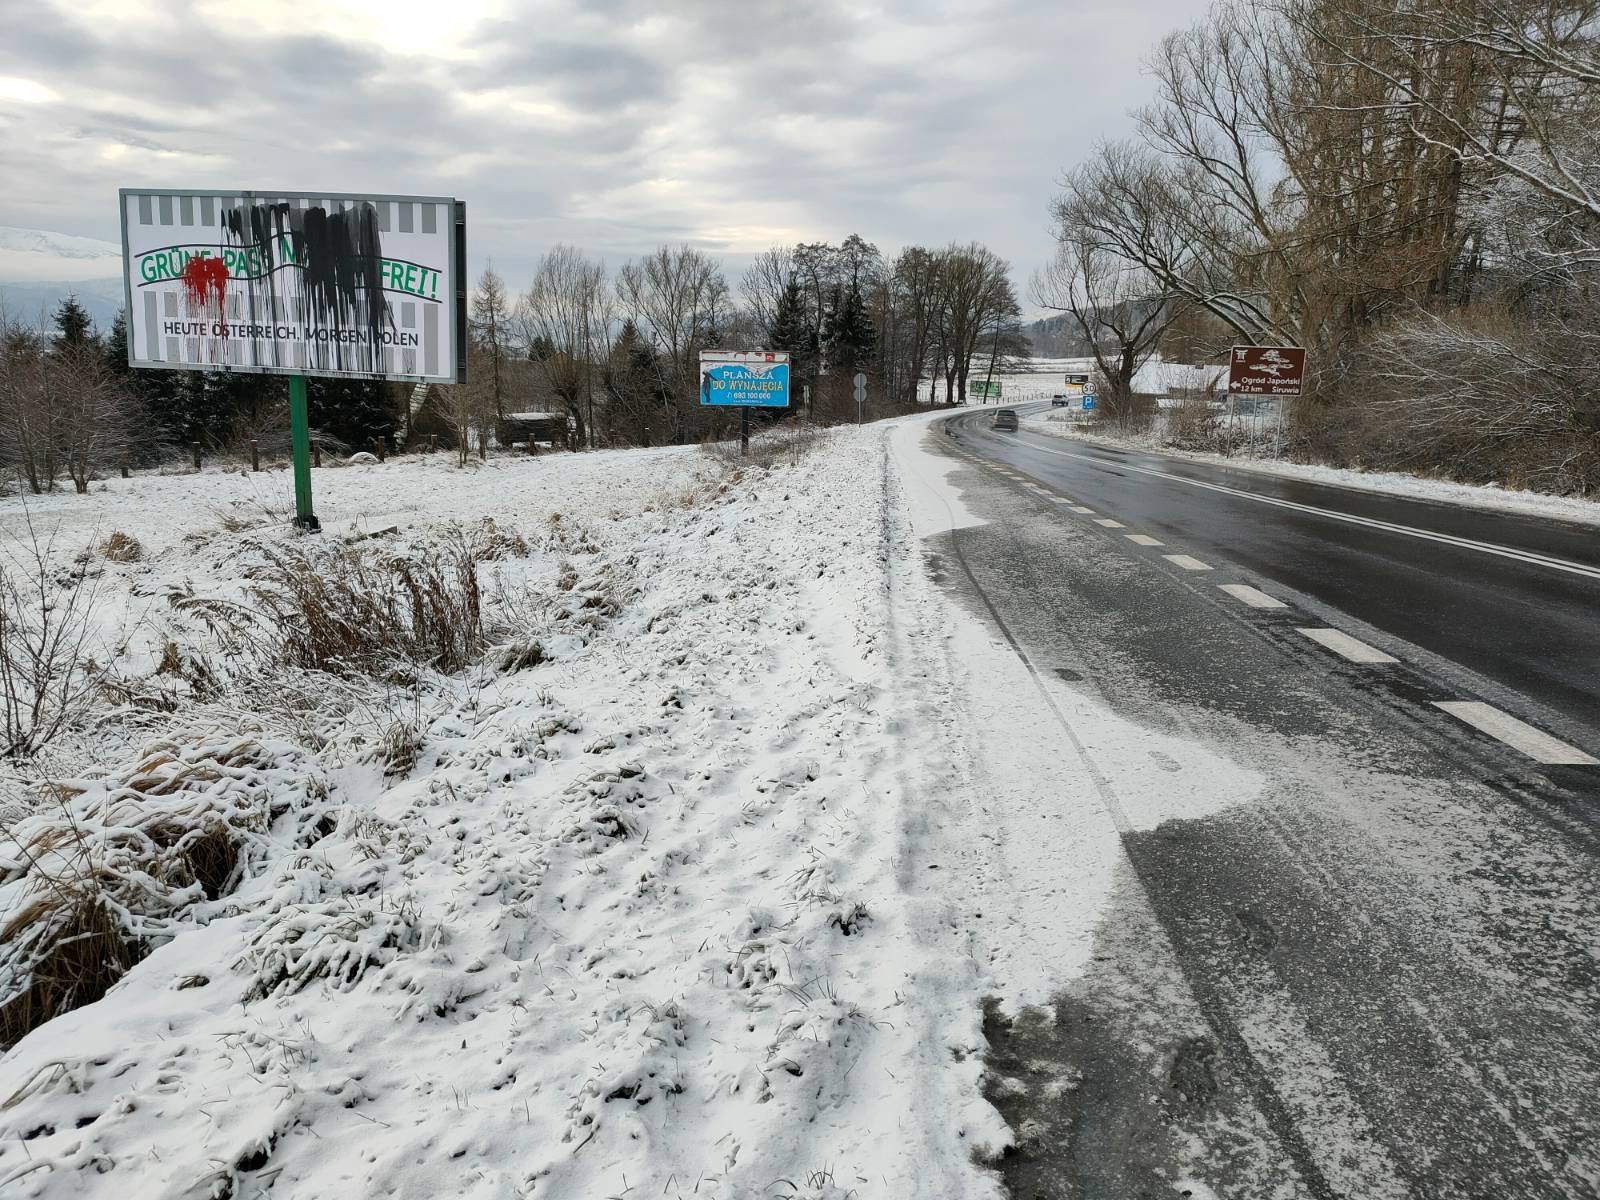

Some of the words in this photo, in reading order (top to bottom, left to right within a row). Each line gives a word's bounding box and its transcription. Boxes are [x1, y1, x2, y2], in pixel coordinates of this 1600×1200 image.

[379, 260, 437, 298] FREI!
[164, 322, 207, 336] HEUTE
[212, 321, 300, 341] ÖSTERREICH,
[305, 327, 367, 344] MORGEN
[723, 371, 774, 380] PLANSZA
[1241, 377, 1265, 385] Ogród
[1267, 377, 1300, 385] Japoński
[713, 380, 726, 390] DO
[729, 380, 783, 392] WYNAJĘCIA
